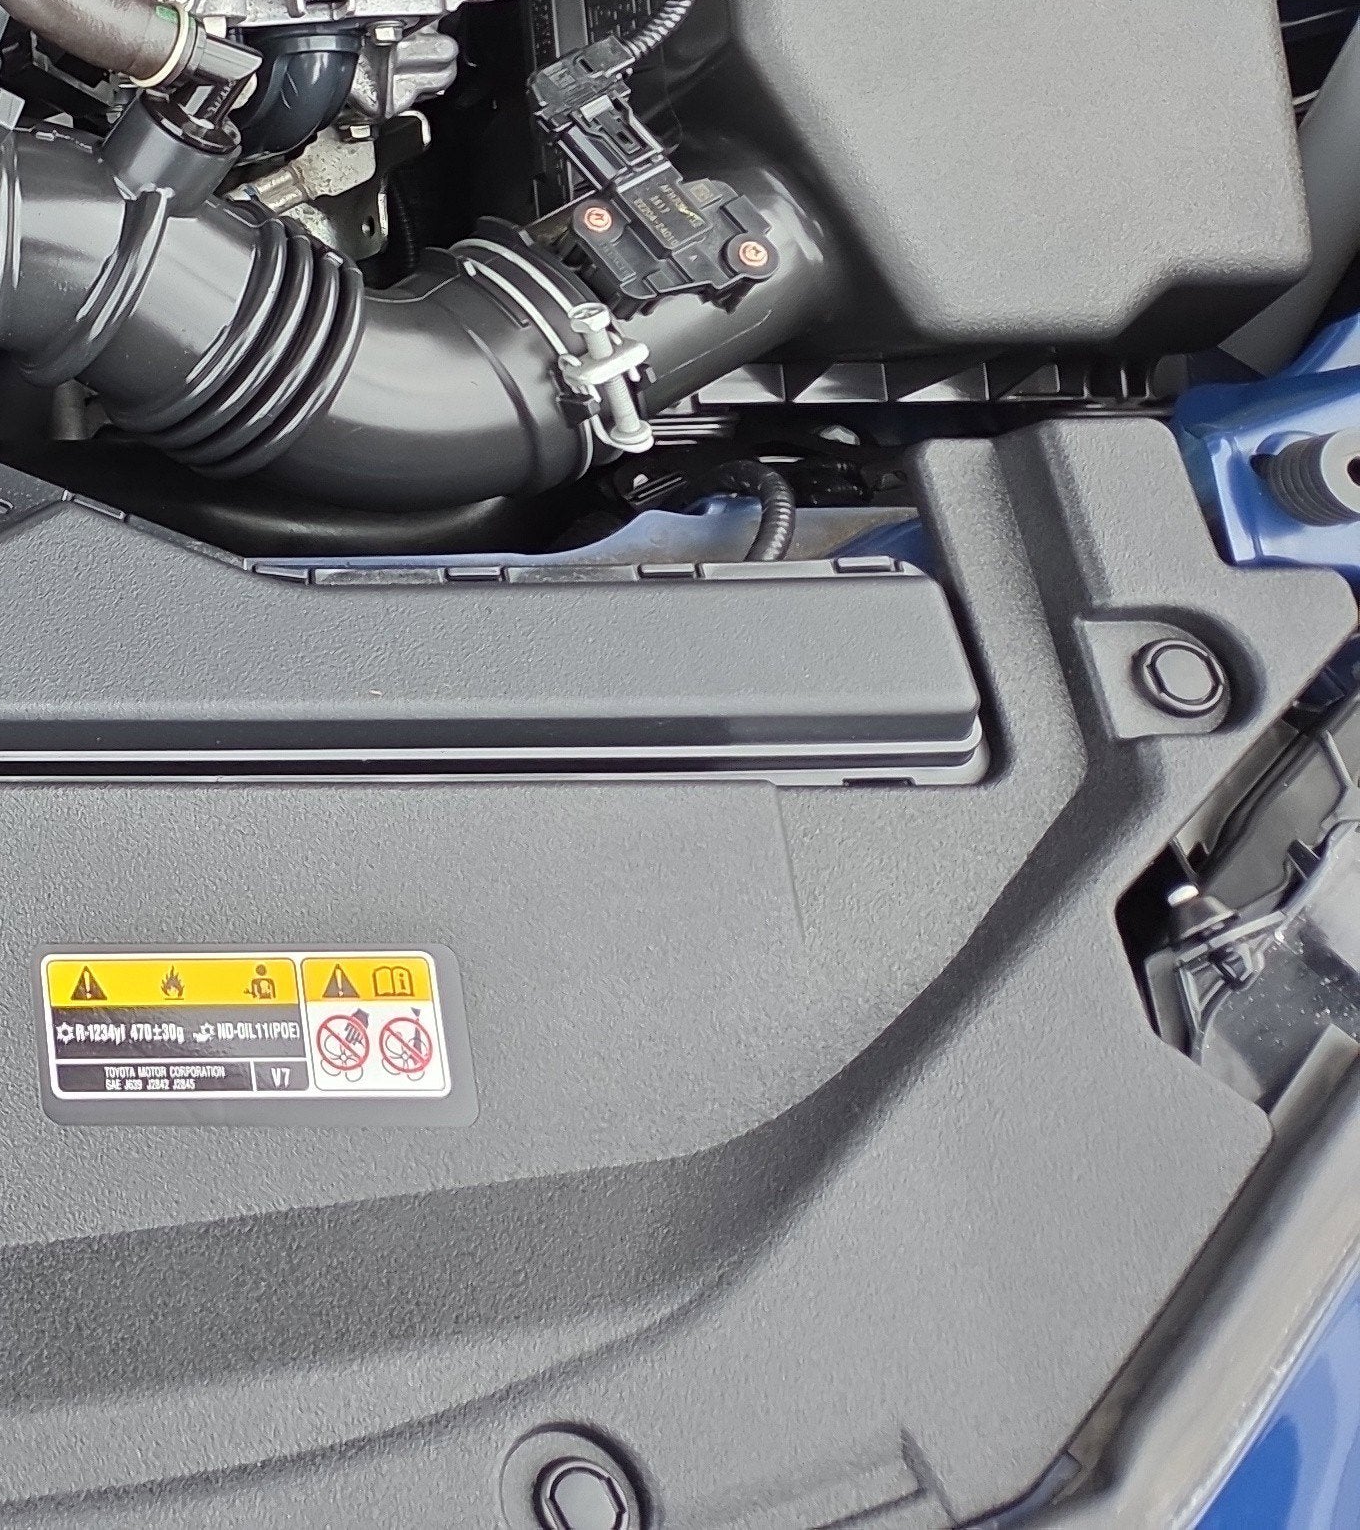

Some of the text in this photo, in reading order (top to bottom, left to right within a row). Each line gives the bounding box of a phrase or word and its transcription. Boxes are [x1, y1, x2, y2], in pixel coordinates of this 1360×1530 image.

[217, 1022, 300, 1040] ND-OIL11(POE)
[104, 1065, 225, 1078] TOYOTA MOTOR CORPORATION
[271, 1067, 290, 1088] V7
[105, 1079, 122, 1090] SAE
